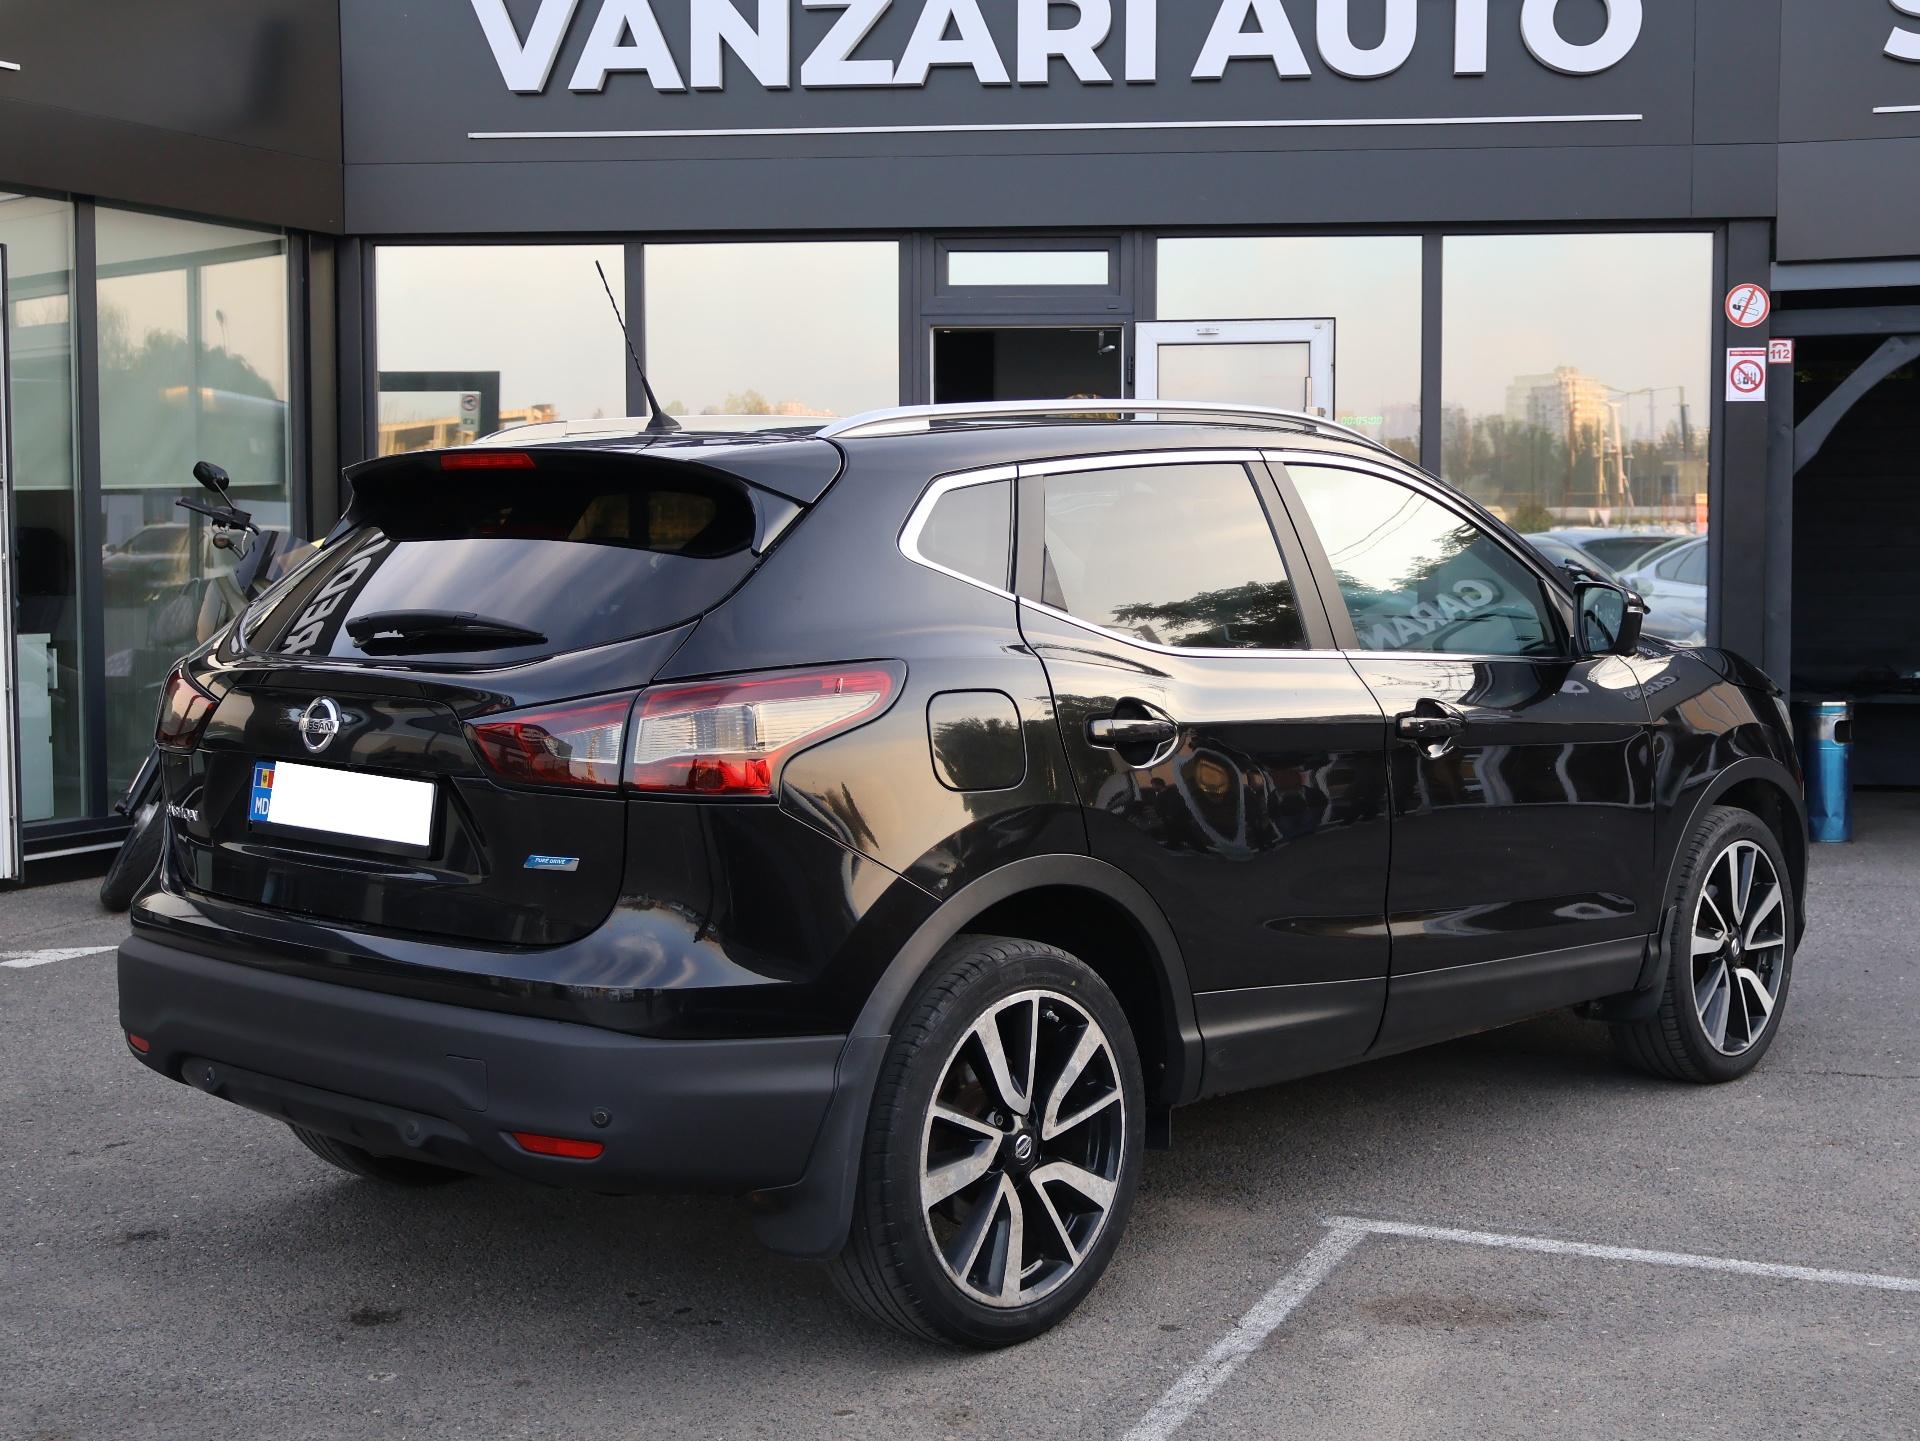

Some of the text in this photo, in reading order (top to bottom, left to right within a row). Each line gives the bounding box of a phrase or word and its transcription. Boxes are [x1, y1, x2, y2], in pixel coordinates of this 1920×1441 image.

[470, 0, 1157, 93] VANZARI
[1770, 349, 1790, 360] 112
[302, 719, 336, 732] NISSAN
[254, 796, 270, 815] MD
